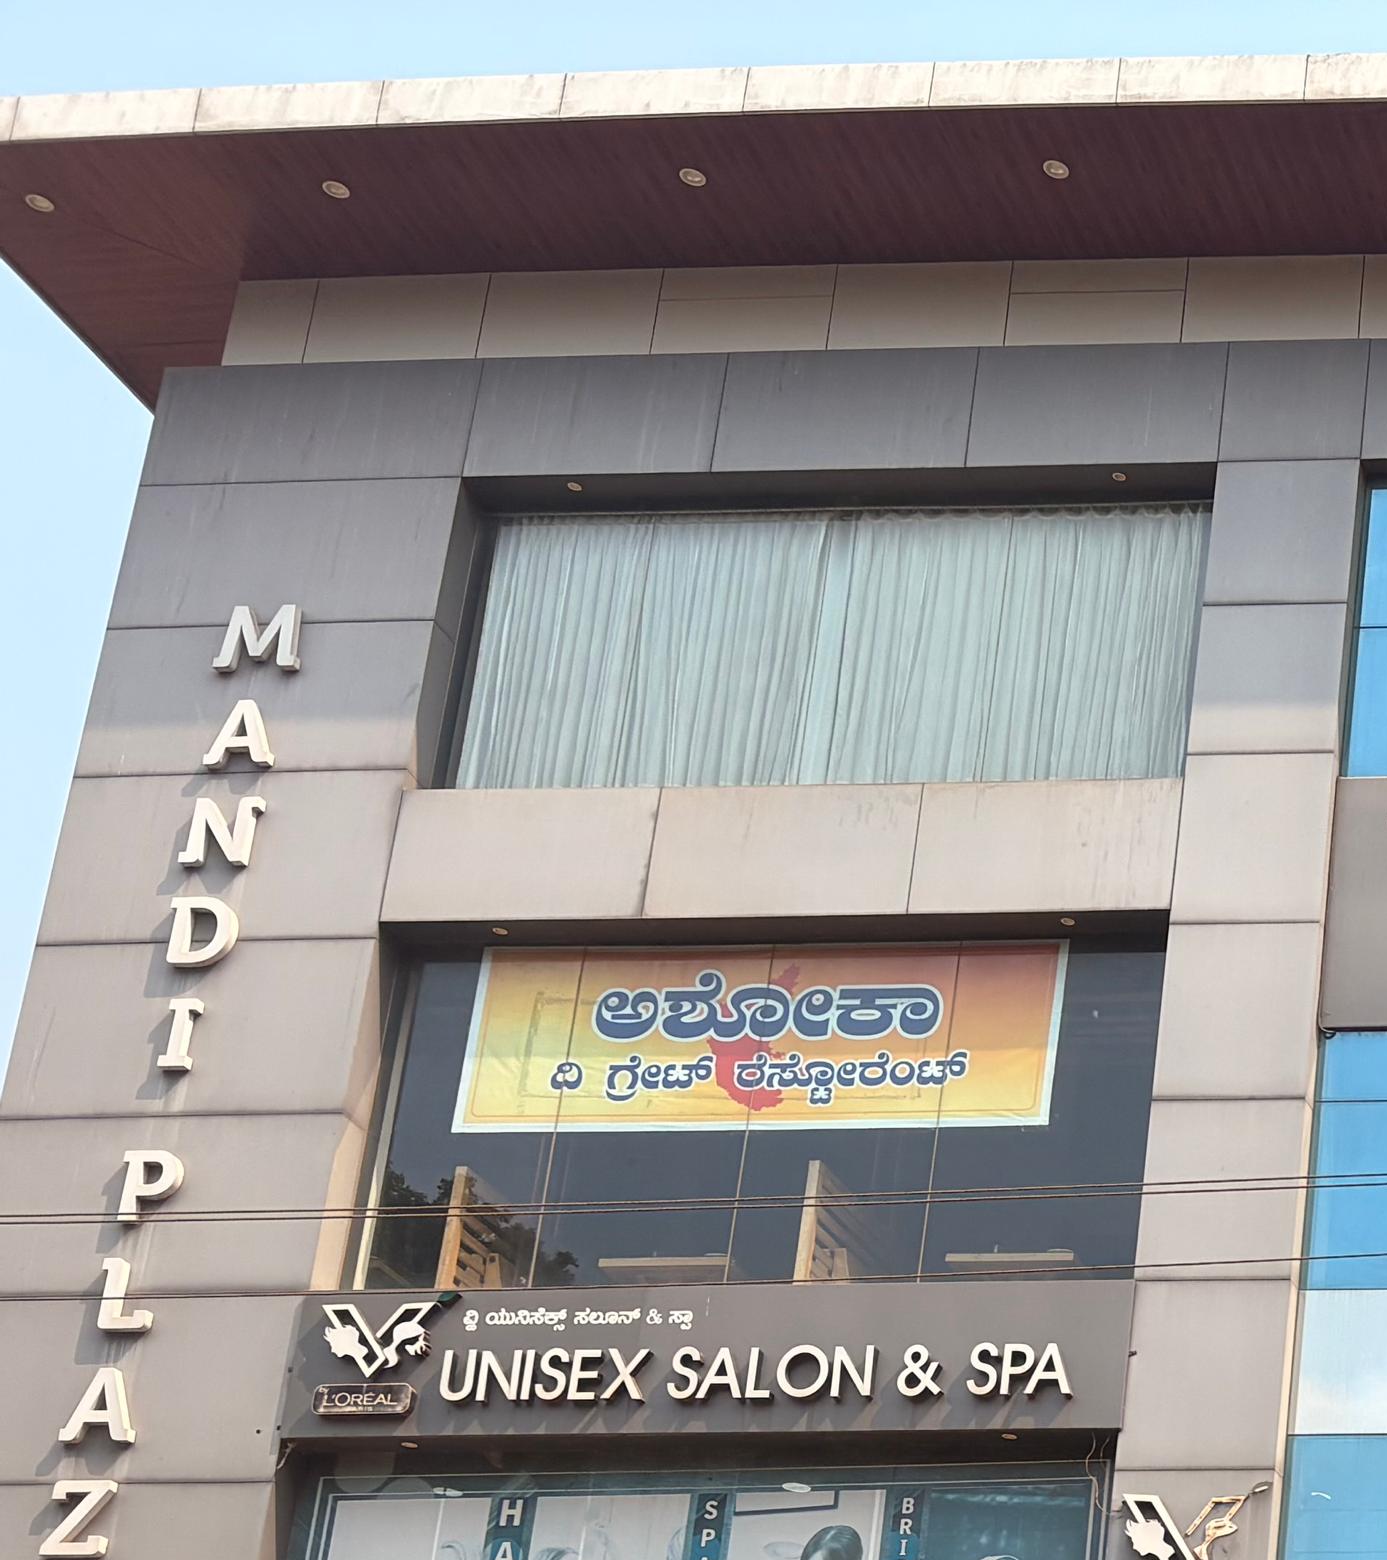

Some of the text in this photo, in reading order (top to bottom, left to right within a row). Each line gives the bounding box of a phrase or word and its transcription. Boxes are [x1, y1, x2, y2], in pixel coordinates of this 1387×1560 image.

[156, 603, 303, 1073] MANDI
[550, 1059, 584, 1091] ದಿ
[606, 1055, 714, 1101] ಗ್ರೇಟ್
[646, 1309, 662, 1324] &
[440, 1341, 1073, 1403] UNISEX SALON & SPA
